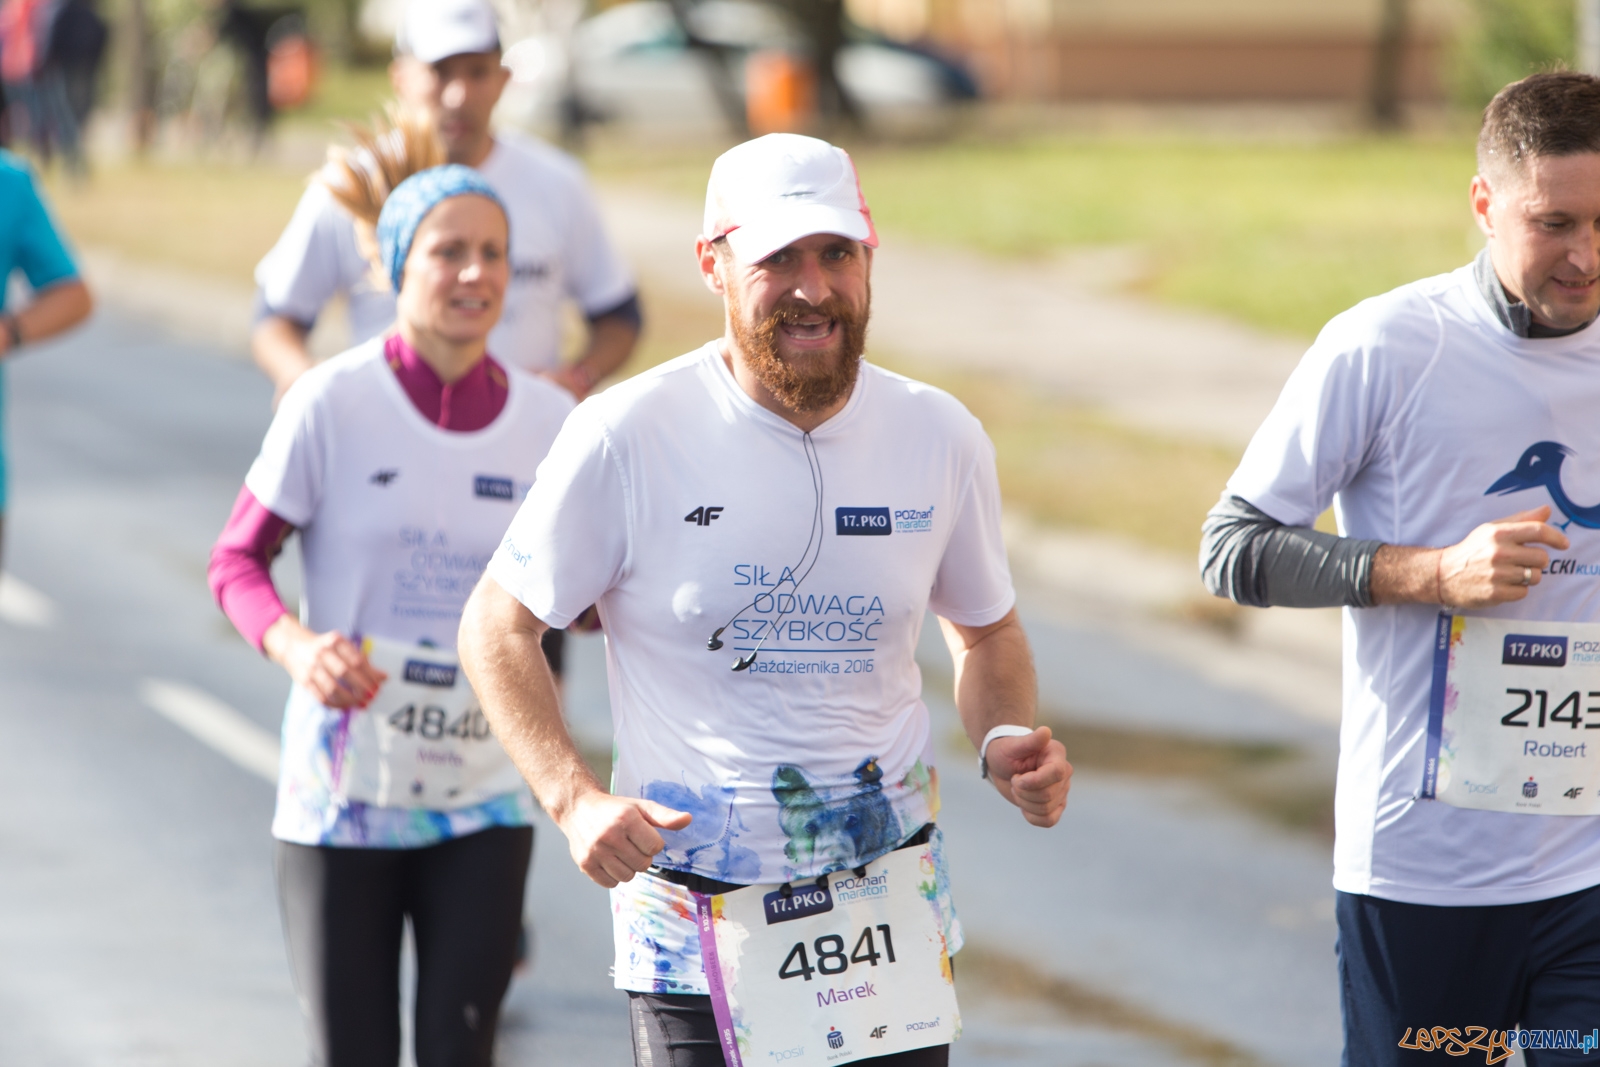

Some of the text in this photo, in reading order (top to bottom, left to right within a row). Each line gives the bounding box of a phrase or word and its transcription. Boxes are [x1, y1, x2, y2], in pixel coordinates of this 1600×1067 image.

[684, 506, 724, 526] 4F
[895, 520, 933, 530] maraton
[733, 564, 797, 588] SIŁA
[753, 592, 885, 616] ODWAGA
[732, 618, 883, 642] SZYBKOŚĆ
[749, 658, 875, 675] października 2016
[1523, 740, 1587, 758] Robert
[1563, 786, 1584, 799] 4F
[837, 885, 888, 902] maraton
[778, 923, 896, 981] 4841
[816, 981, 878, 1008] Marek
[869, 1024, 888, 1040] 4F
